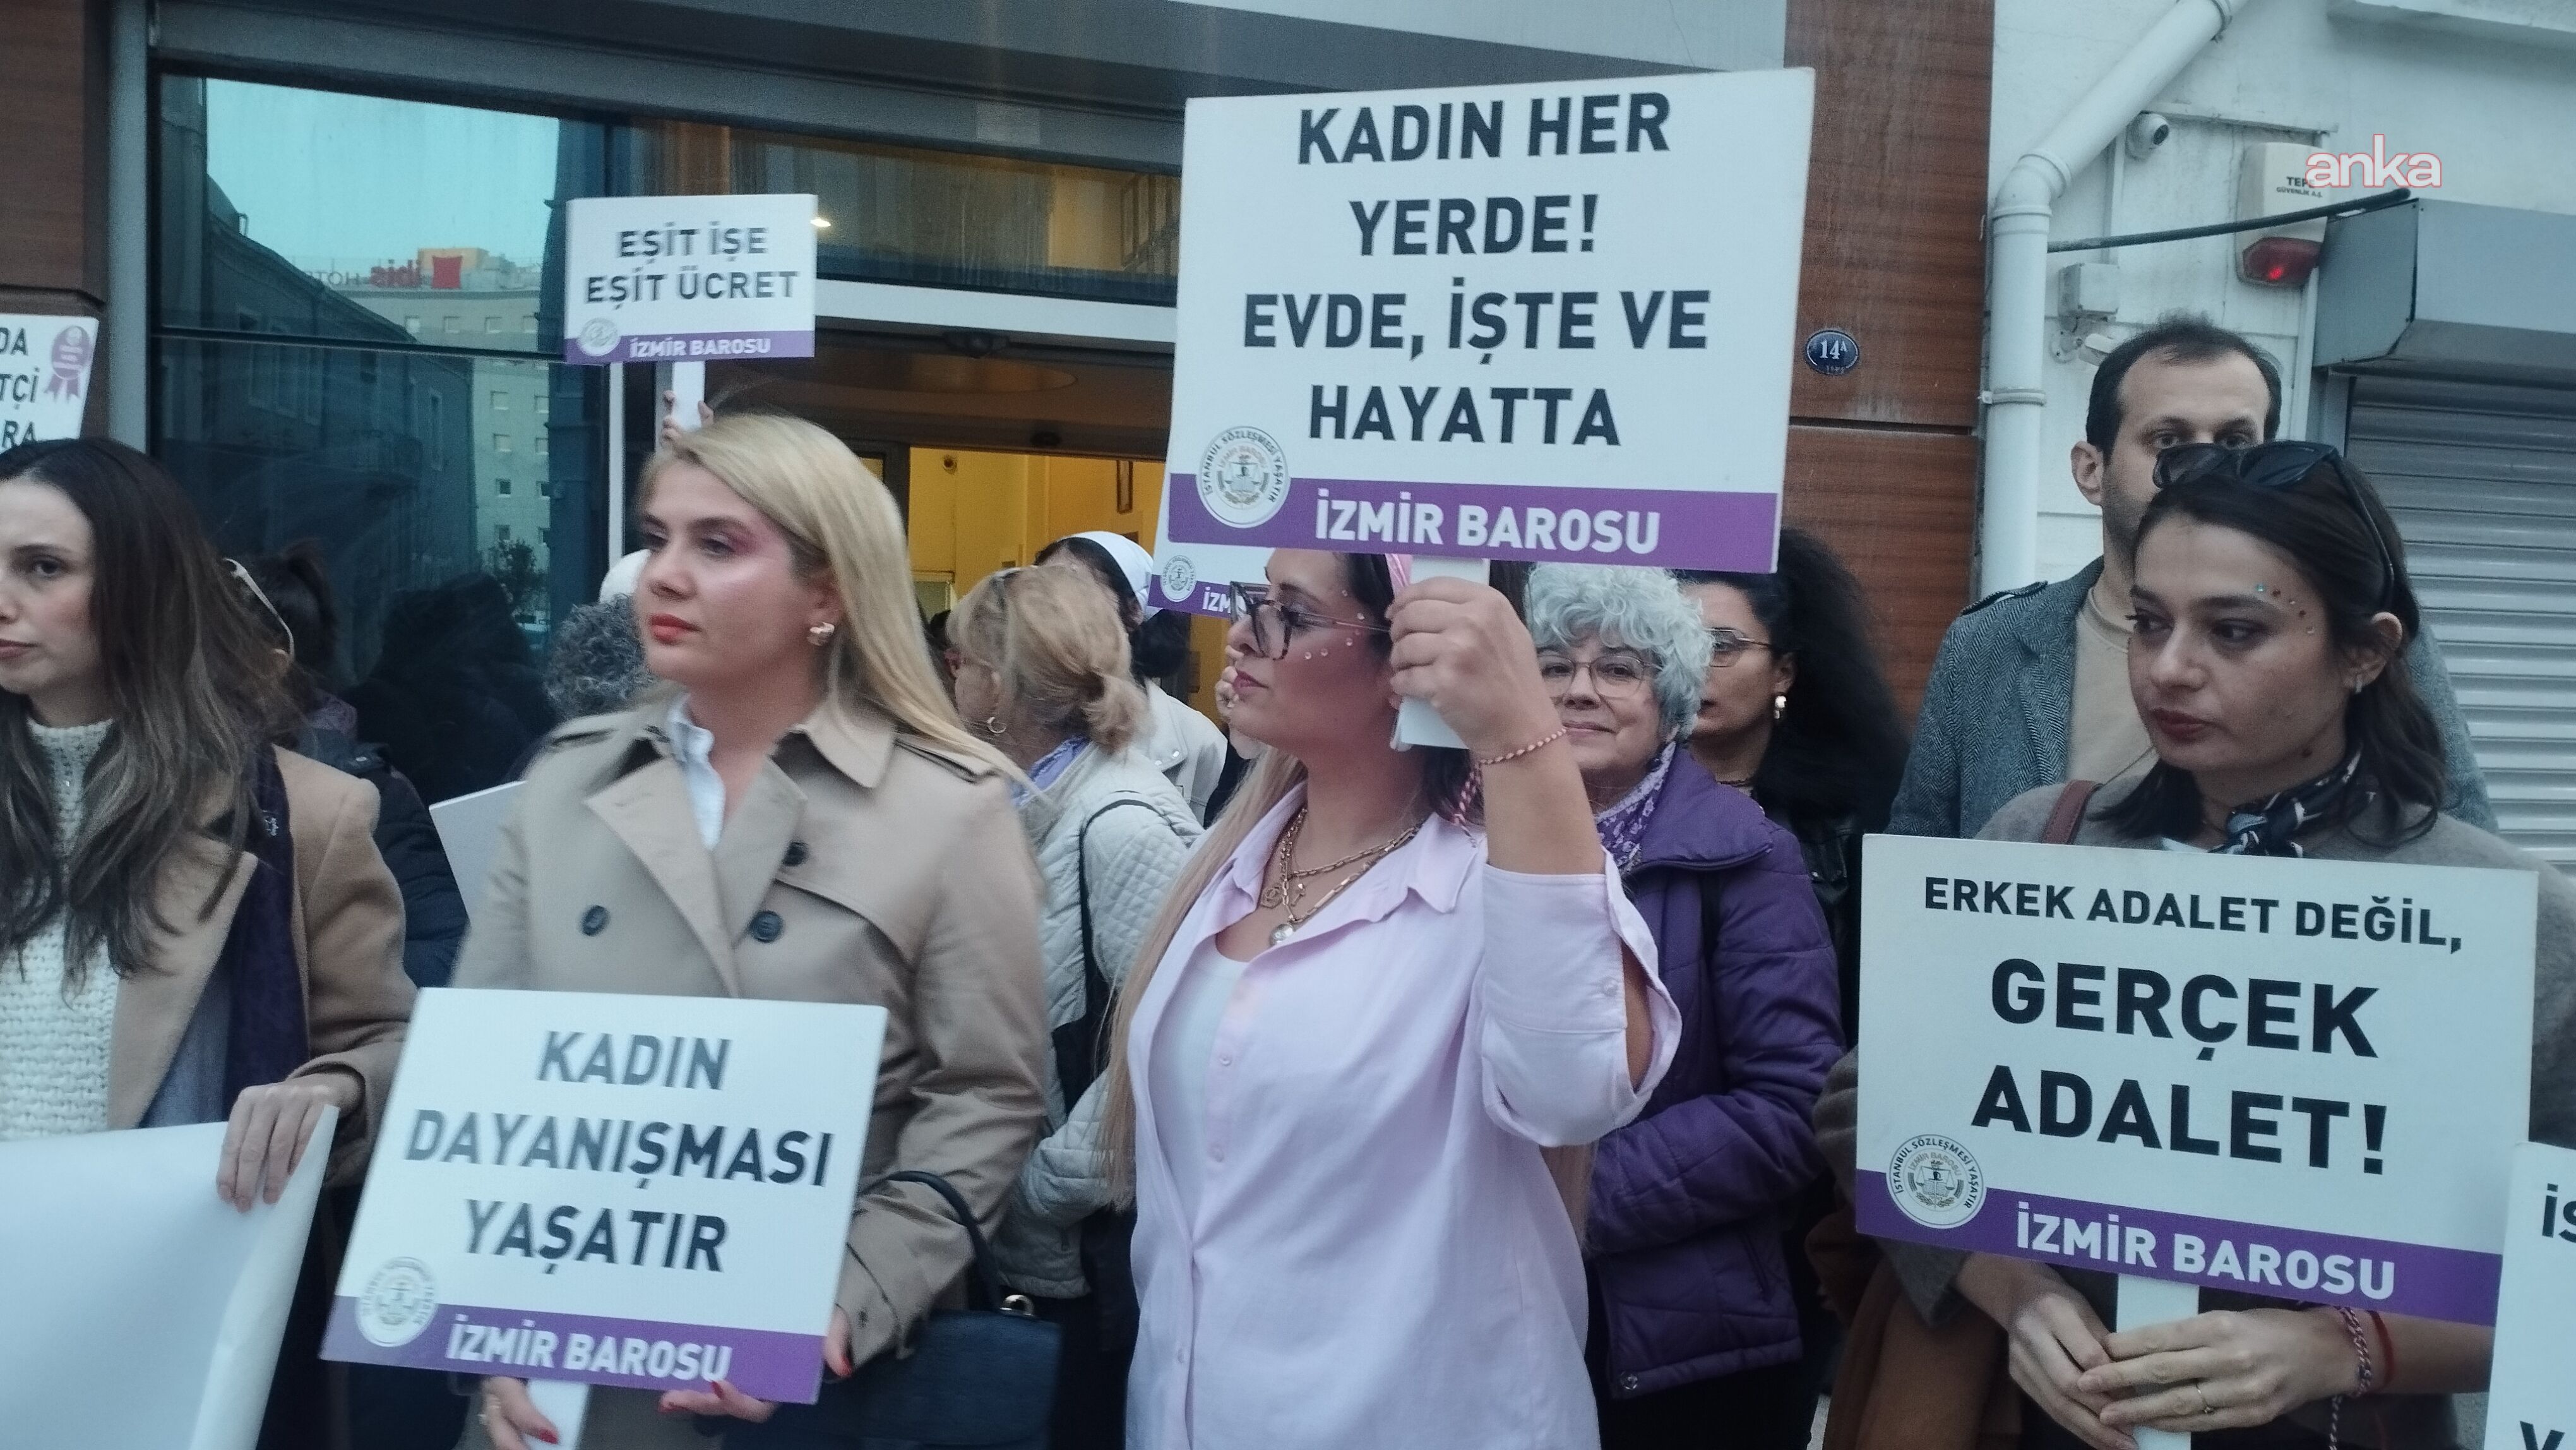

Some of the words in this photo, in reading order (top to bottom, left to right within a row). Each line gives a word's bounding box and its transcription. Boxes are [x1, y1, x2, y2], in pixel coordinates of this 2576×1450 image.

[1298, 100, 1503, 165] KADIN
[1527, 92, 1671, 157] HER
[617, 222, 700, 263] EŞİT
[708, 220, 768, 262] İŞE
[1349, 193, 1599, 256] YERDE!
[585, 267, 667, 309] EŞİT
[677, 265, 798, 300] ÜCRET
[1244, 293, 1425, 361] EVDE,
[1448, 277, 1598, 365] İŞTE
[1619, 290, 1710, 349] VE
[630, 337, 687, 358] İZMİR
[689, 338, 772, 356] BAROSU
[1309, 385, 1621, 446] HAYATTA
[1315, 488, 1444, 545] İZMİR
[1457, 505, 1661, 554] BAROSU
[1202, 586, 1231, 614] İZM
[1925, 876, 2075, 920] ERKEK
[2086, 888, 2279, 933] ADALET
[2295, 895, 2462, 954] DEĞİL,
[1991, 958, 2379, 1062] GERÇEK
[536, 1031, 732, 1091] KADIN
[404, 1110, 833, 1189] DAYANIŞMASI
[1971, 1065, 2388, 1176] ADALET!
[1893, 1147, 1912, 1194] İSTANBUL
[1912, 1137, 1974, 1165] SÖZLEŞMESİ
[1963, 1166, 1979, 1209] YAŞATIR
[466, 1199, 728, 1274] YAŞATIR
[2017, 1202, 2158, 1269] İZMİR
[2173, 1232, 2396, 1301] BAROSU
[446, 1314, 559, 1369] İZMİR
[563, 1333, 733, 1382] BAROSU
